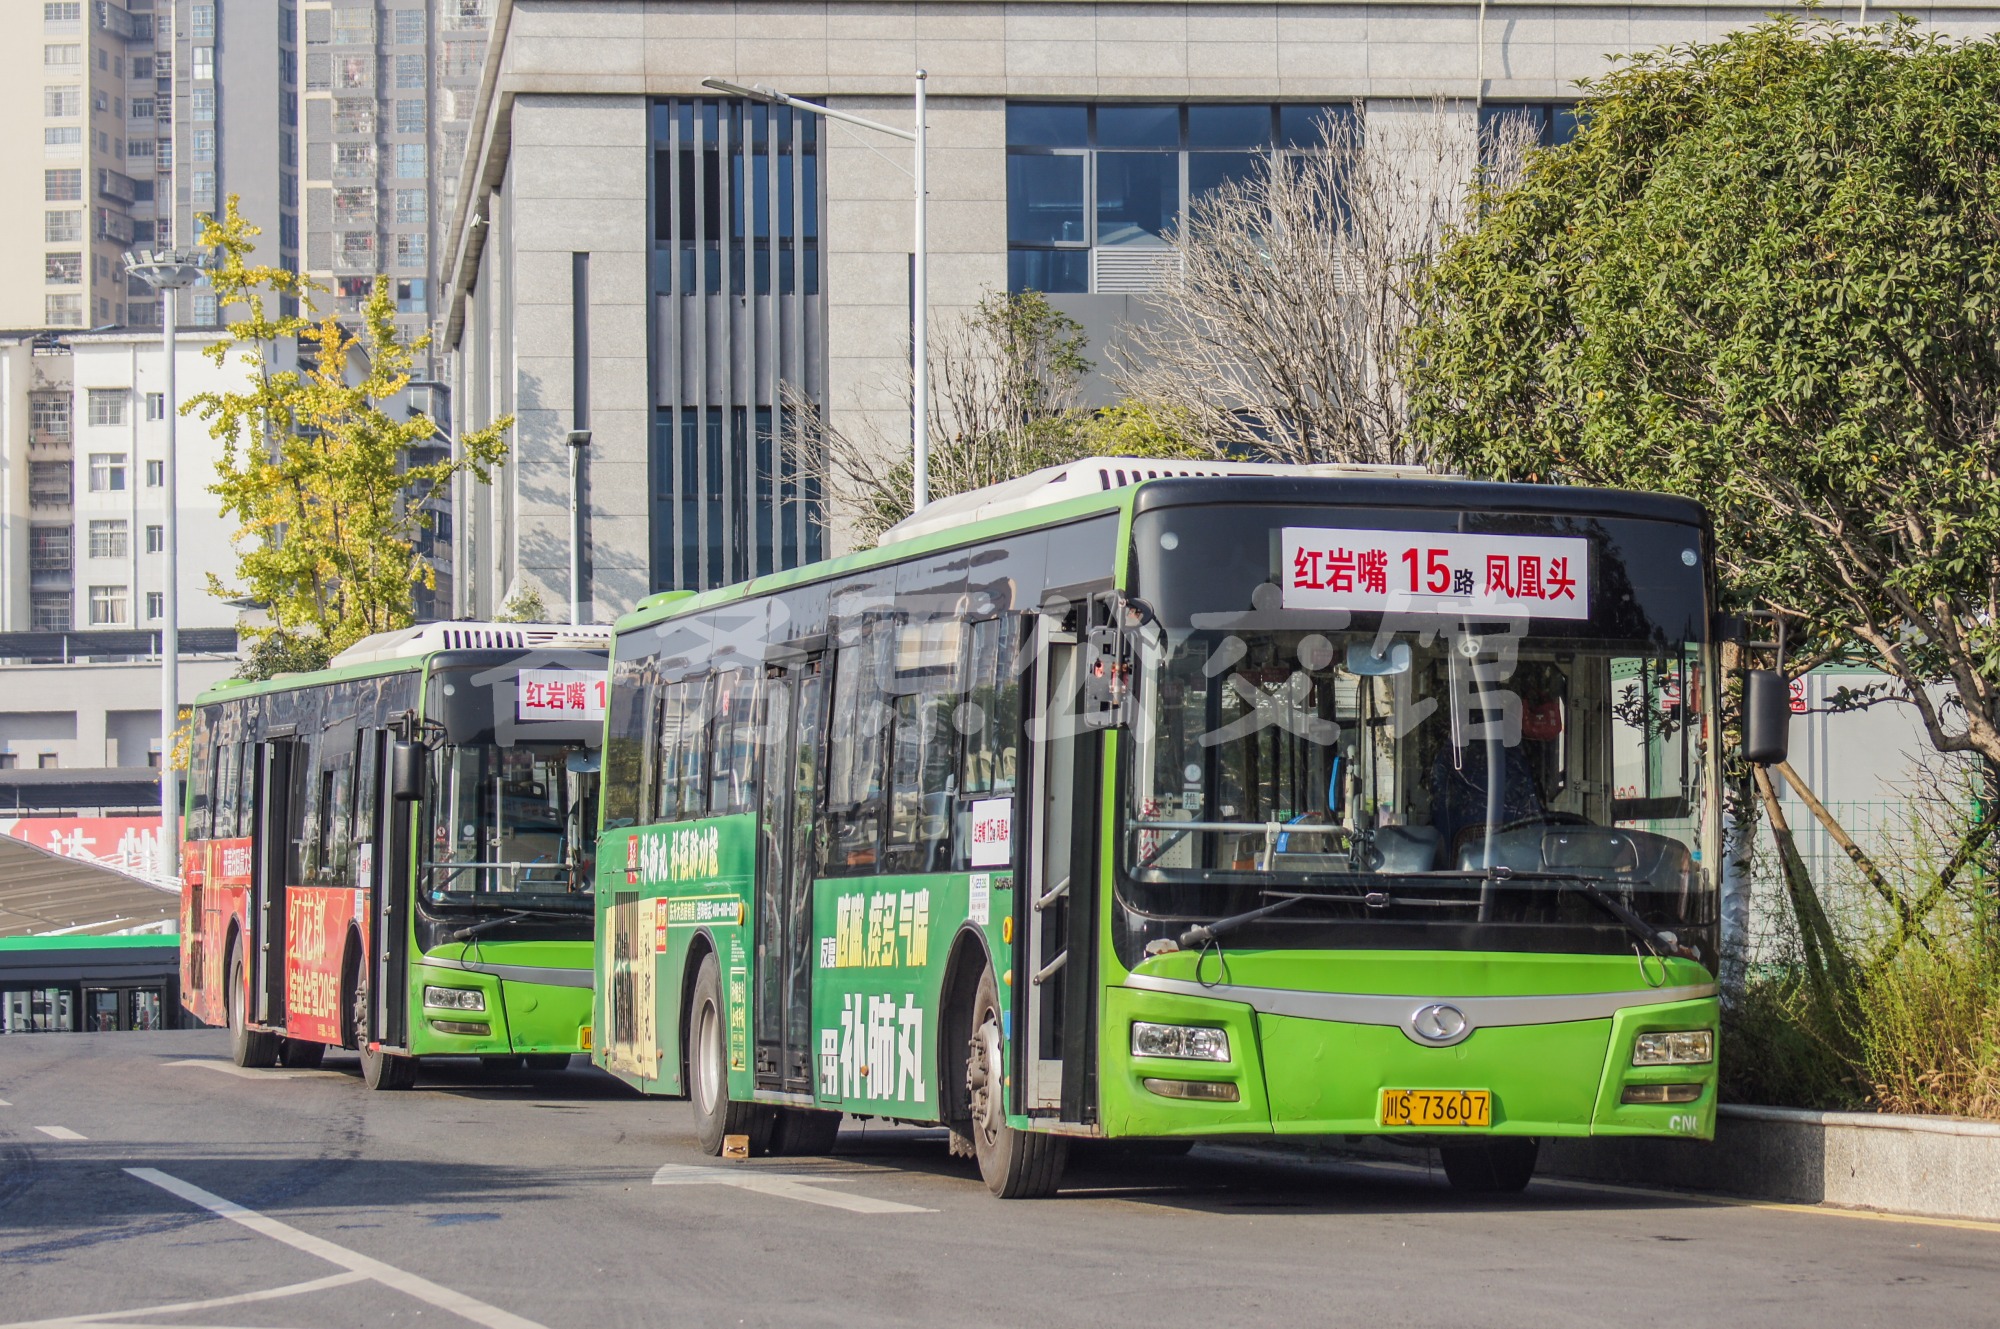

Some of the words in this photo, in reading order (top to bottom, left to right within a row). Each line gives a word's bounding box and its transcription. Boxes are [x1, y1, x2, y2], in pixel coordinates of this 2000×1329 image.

[1293, 546, 1388, 594] 红岩嘴
[1483, 554, 1577, 601] 凤凰头
[525, 680, 586, 710] 红岩嘴
